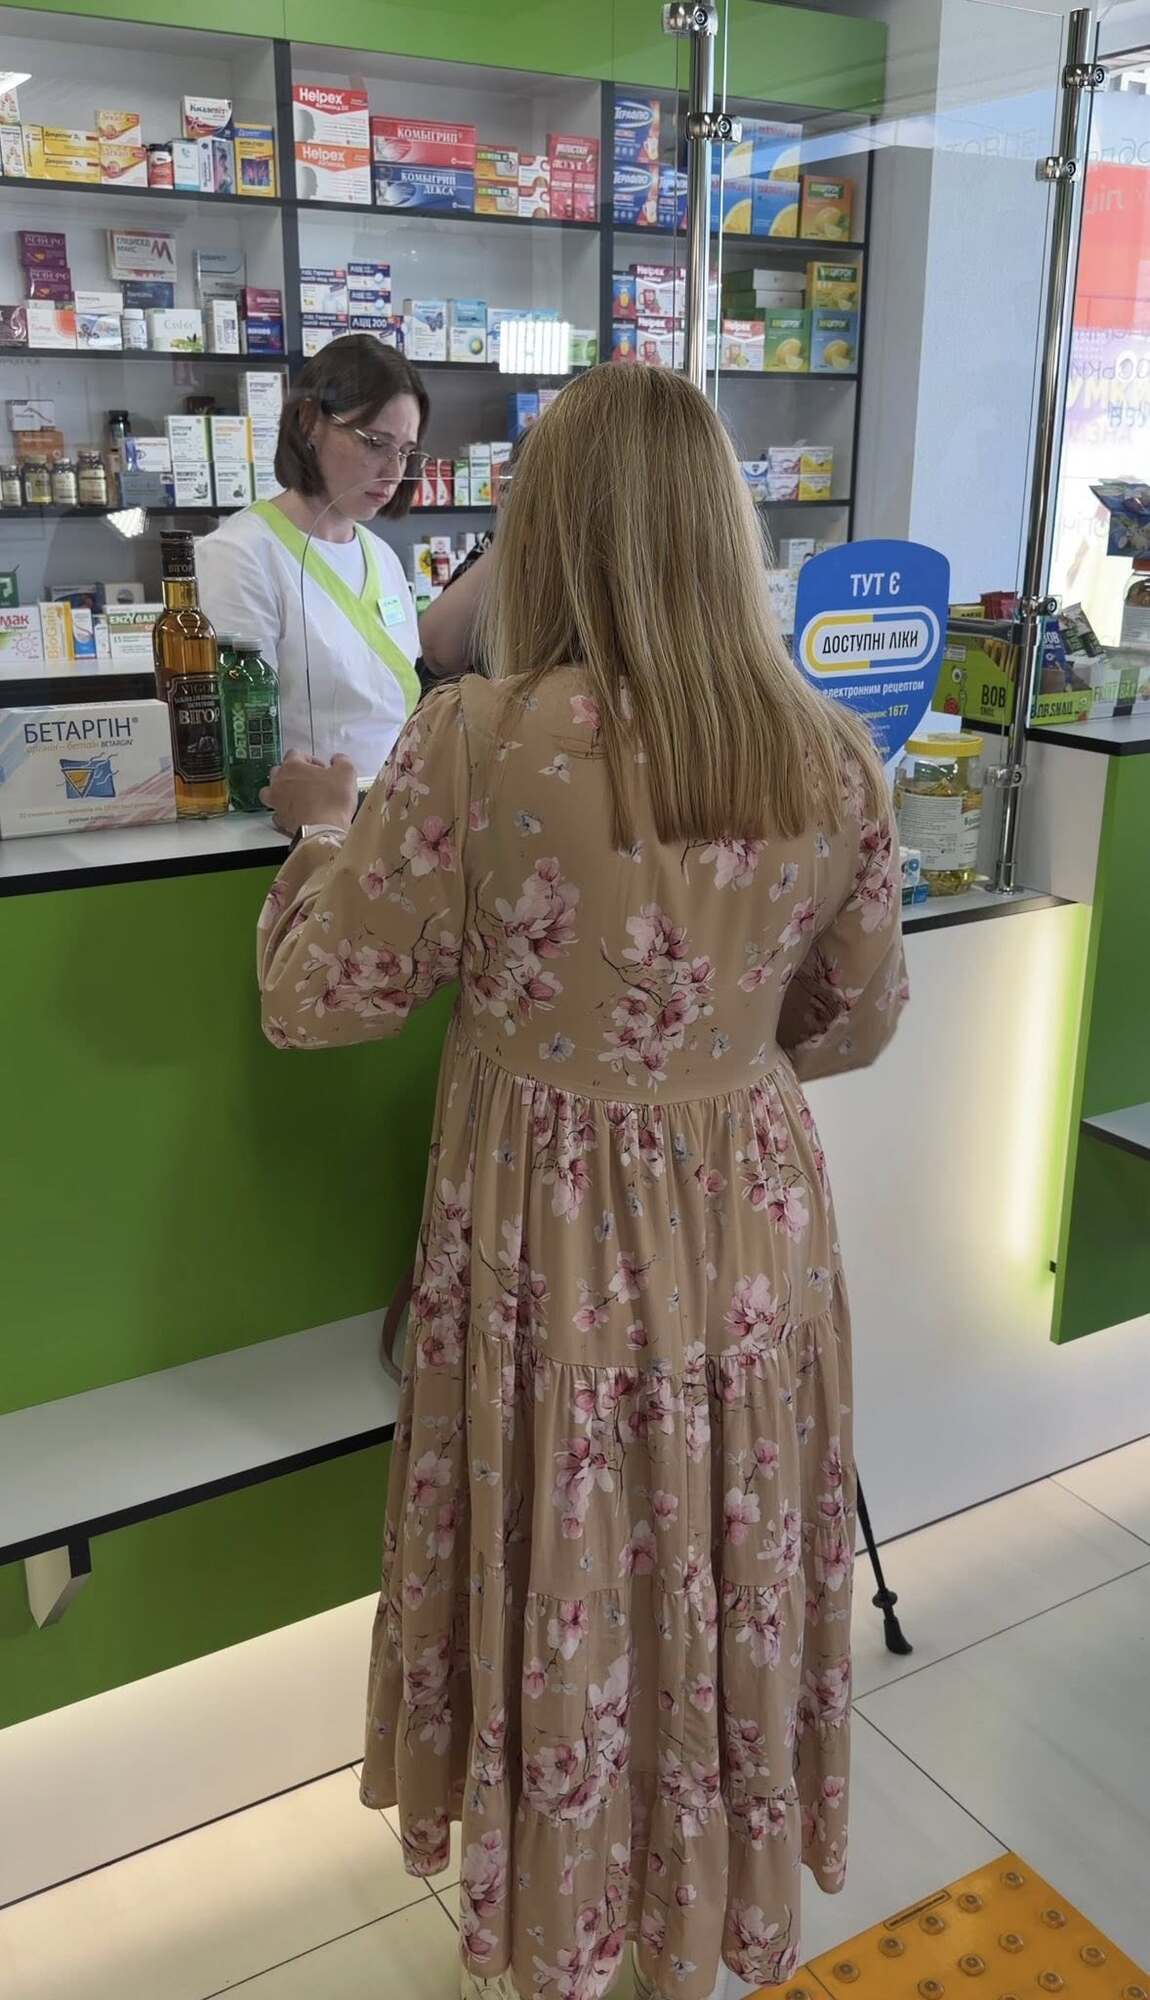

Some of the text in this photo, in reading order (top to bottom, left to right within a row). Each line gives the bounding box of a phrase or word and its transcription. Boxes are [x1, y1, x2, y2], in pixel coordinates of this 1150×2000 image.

[299, 87, 343, 105] Helpex
[302, 145, 346, 162] Helpex
[372, 318, 388, 328] 200
[851, 572, 900, 597] ТУТ Є
[822, 630, 918, 654] ДОСТУПНІ ЛІКИ
[823, 681, 925, 698] електронним рецептом
[981, 684, 1006, 708] BOB
[24, 717, 131, 744] БЕТАРГІН
